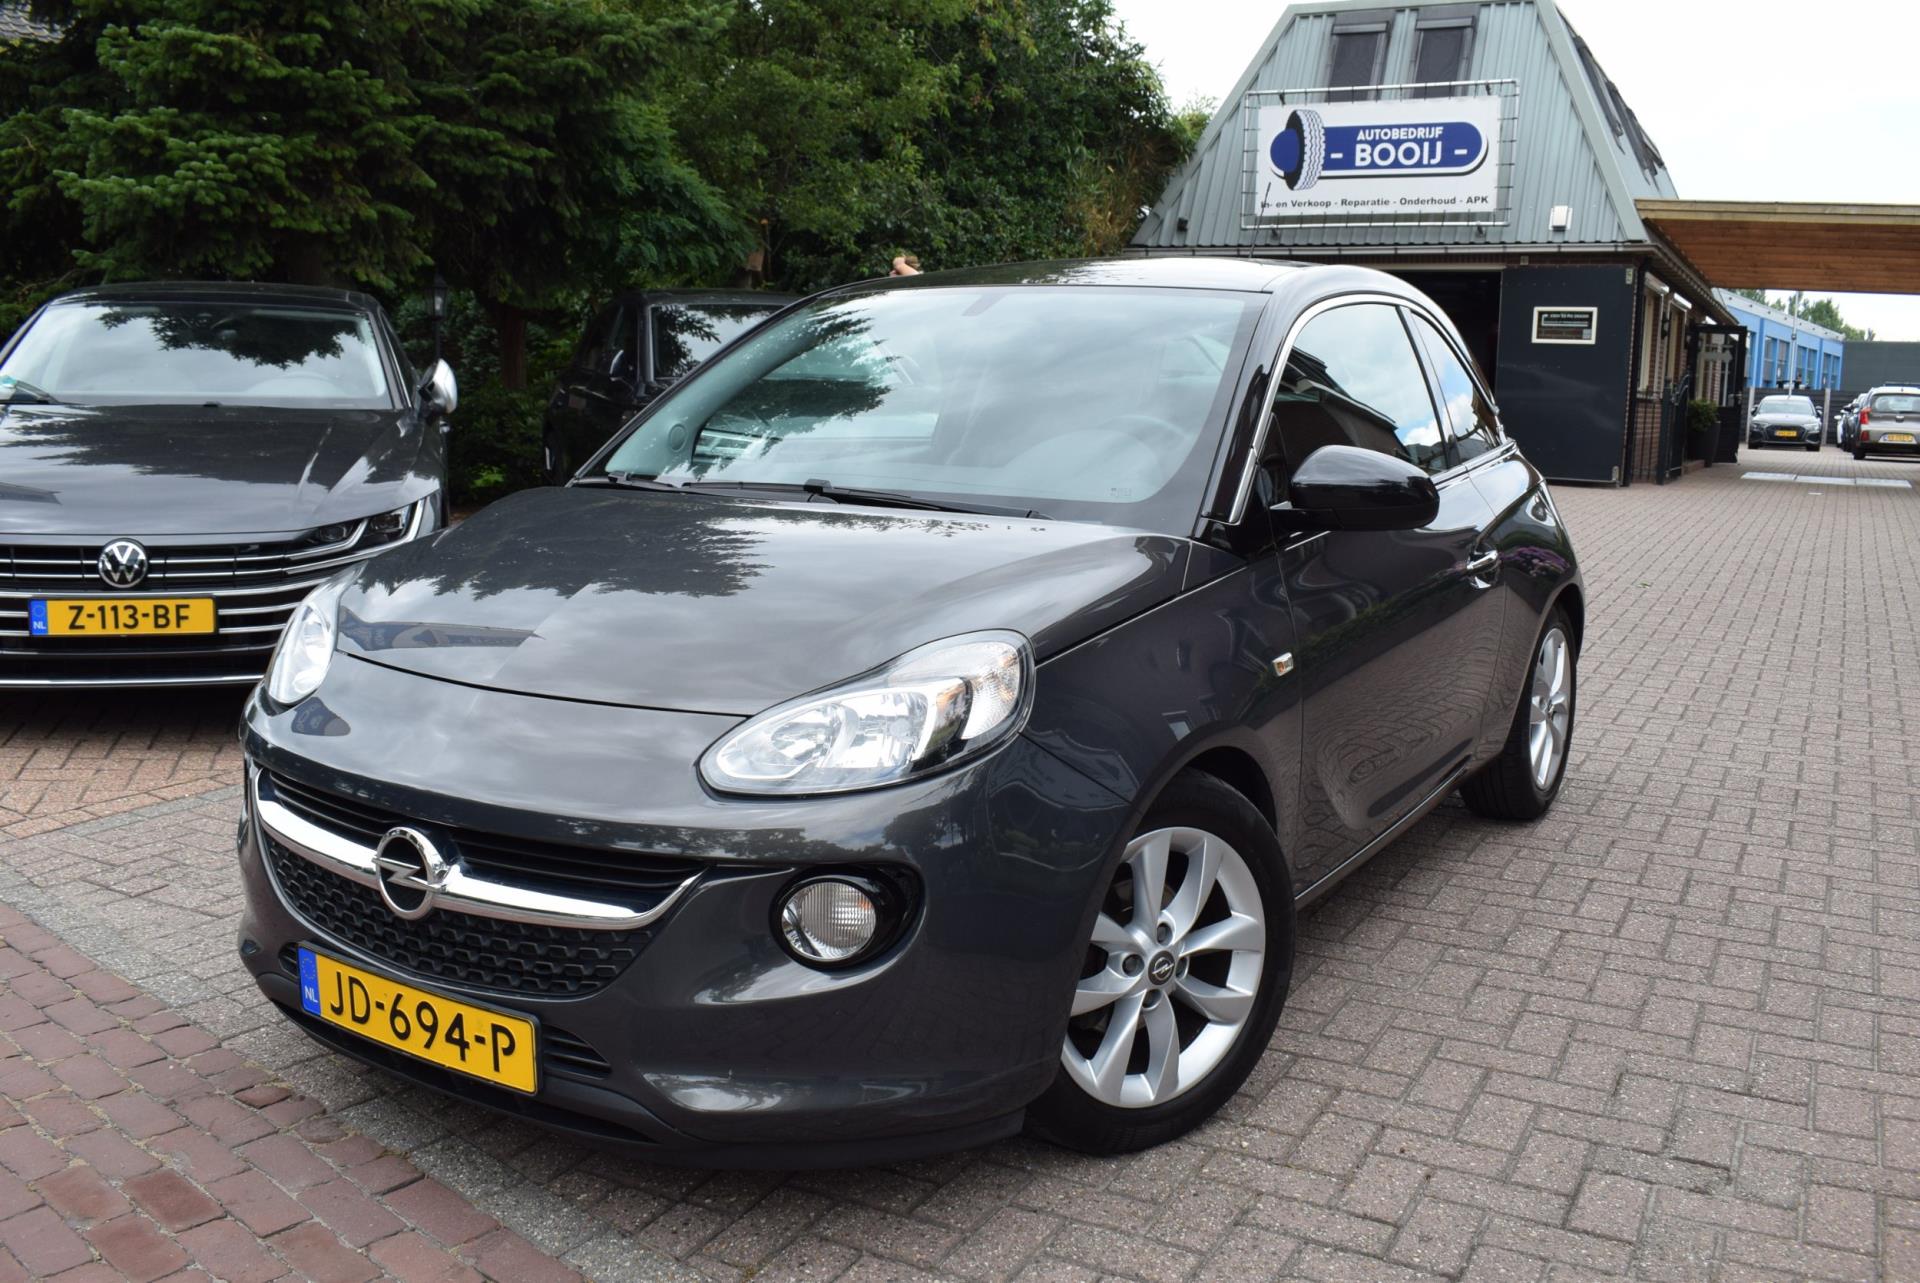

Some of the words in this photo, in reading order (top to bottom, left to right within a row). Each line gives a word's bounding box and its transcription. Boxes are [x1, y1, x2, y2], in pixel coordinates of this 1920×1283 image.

[1356, 126, 1444, 141] AUTOBEDRIJF
[1354, 141, 1443, 167] BOOIJ
[1291, 199, 1332, 208] Verkoop
[1341, 197, 1390, 207] Reparatie
[1399, 196, 1457, 206] Onderhoud
[1466, 195, 1489, 204] APK
[33, 620, 47, 630] NL
[67, 604, 190, 630] Z-113-BF
[304, 984, 319, 1003] NL
[329, 970, 517, 1073] JD-694-P
